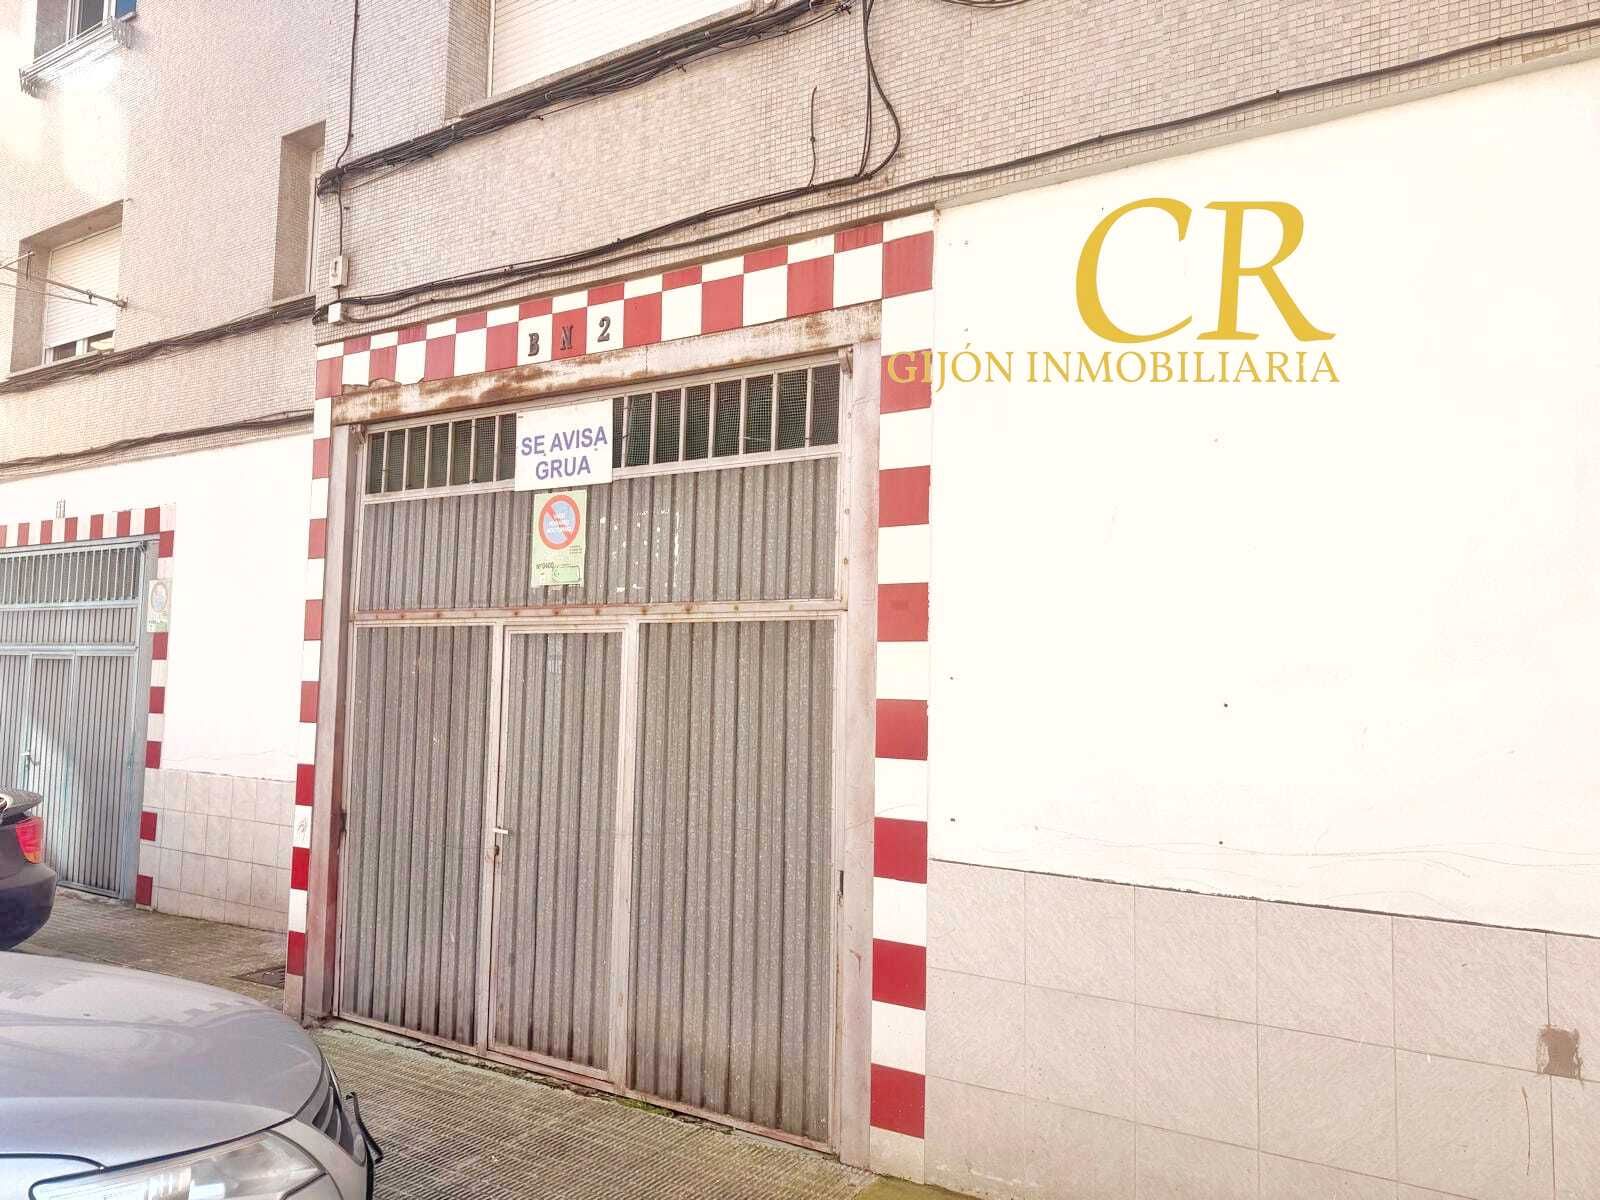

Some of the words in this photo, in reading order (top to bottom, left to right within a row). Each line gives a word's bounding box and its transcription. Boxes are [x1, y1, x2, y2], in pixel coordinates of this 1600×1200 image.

[528, 332, 540, 356] B
[597, 316, 611, 342] 2
[521, 435, 545, 456] SE
[550, 426, 608, 453] AVISA
[535, 456, 591, 480] GRUA
